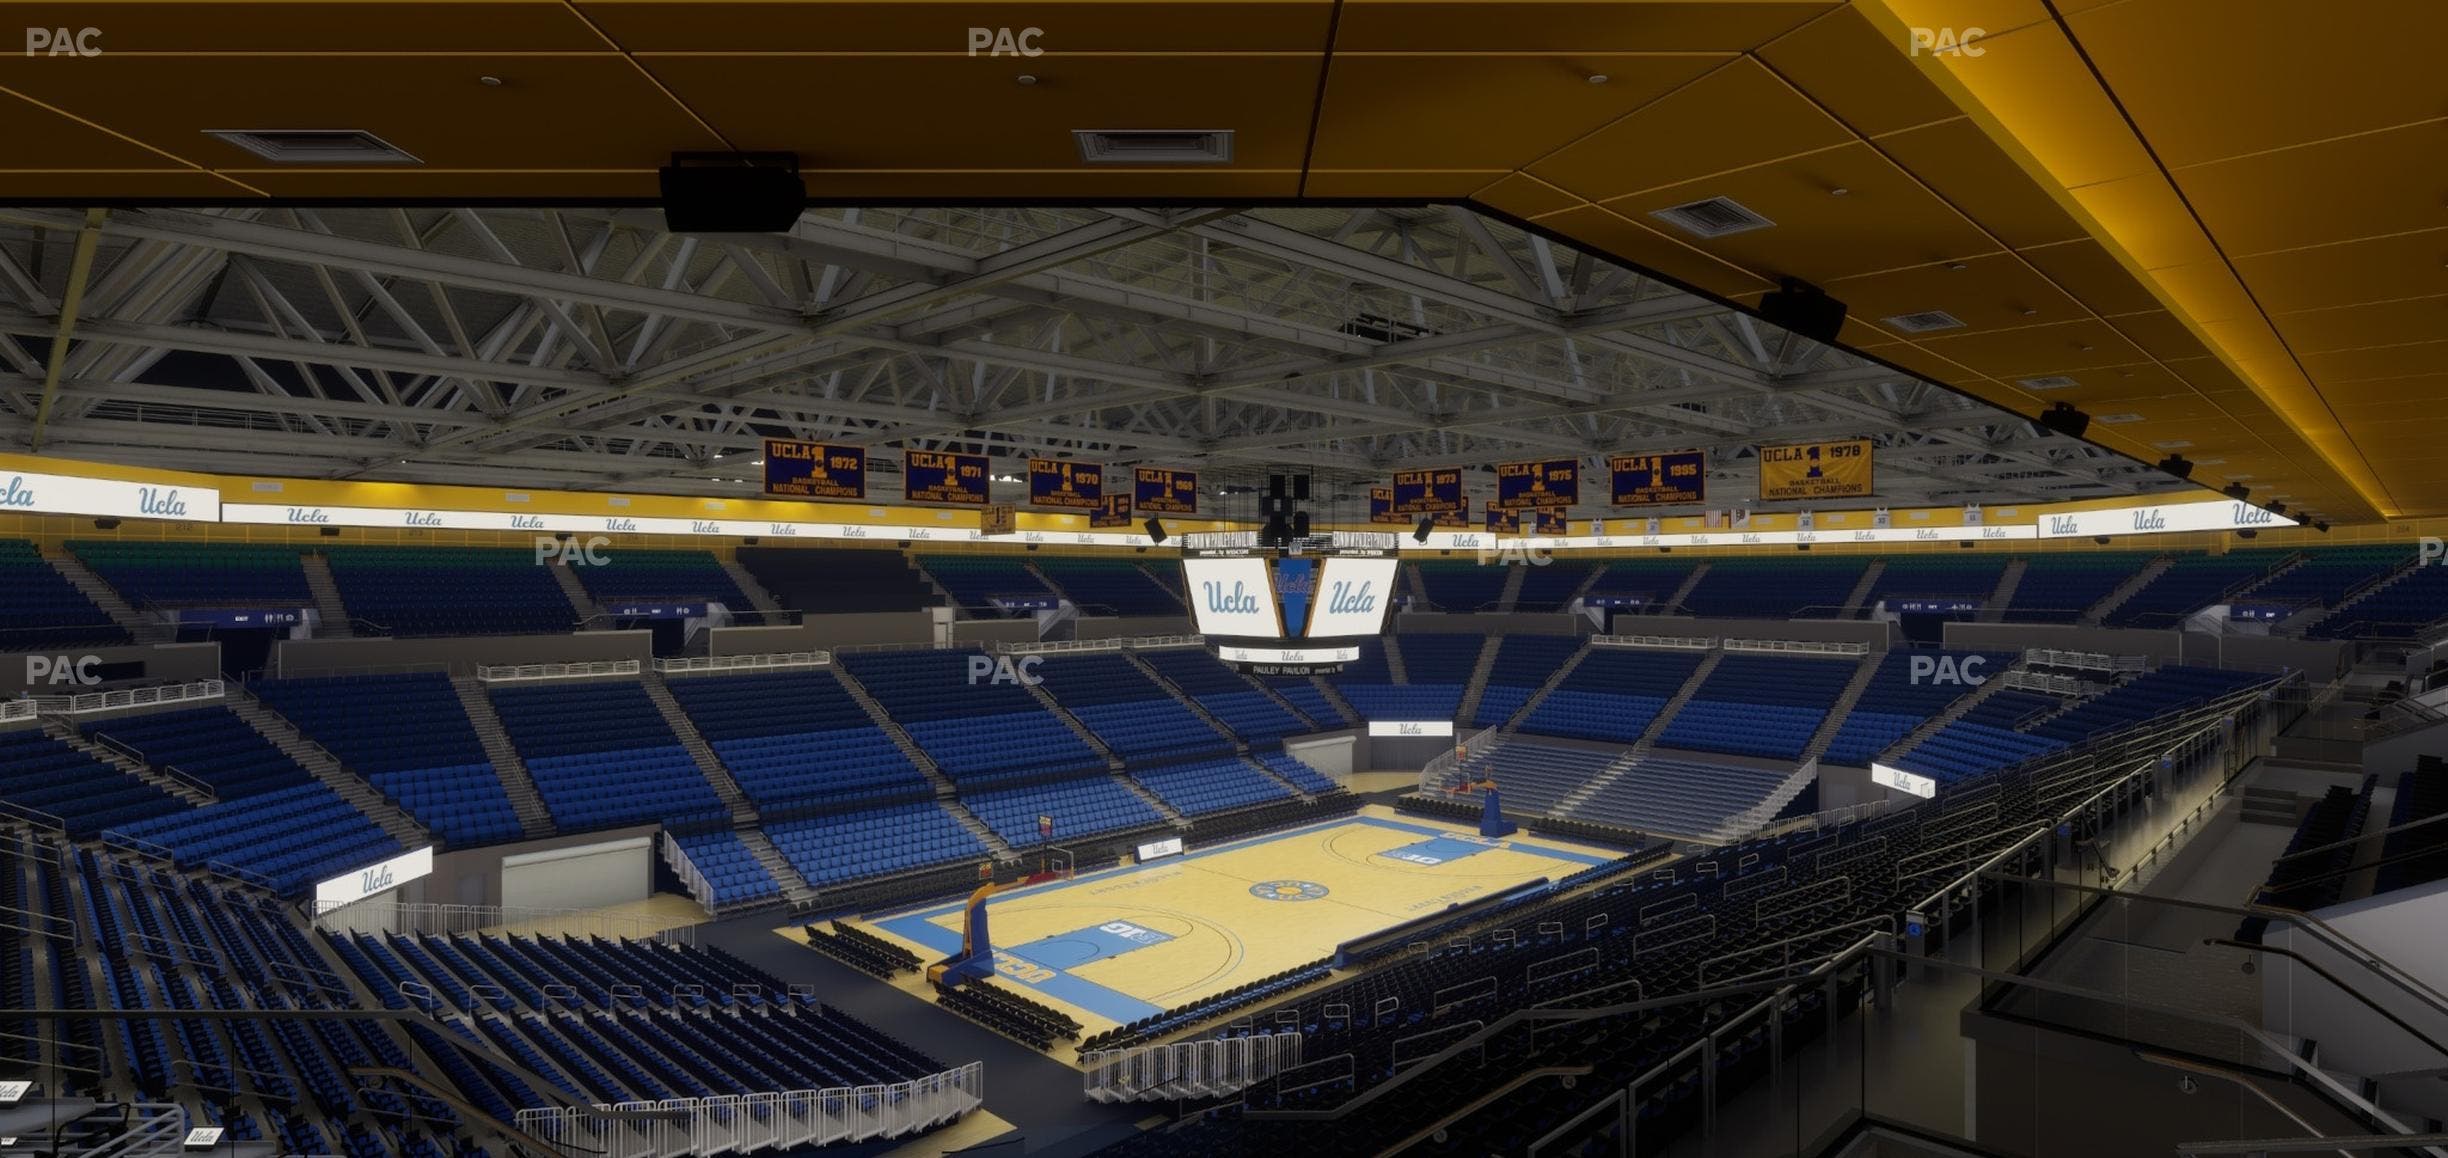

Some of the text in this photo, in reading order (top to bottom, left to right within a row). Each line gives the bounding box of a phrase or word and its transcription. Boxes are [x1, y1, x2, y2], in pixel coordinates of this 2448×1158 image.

[772, 443, 858, 479] UCLA 1 1972
[1763, 445, 1862, 478] UCLA 1 1978
[911, 454, 982, 486] UCLA 1 1971
[1031, 460, 1099, 492] UCLA 1 1970
[1613, 459, 1648, 472] UCLA
[1650, 457, 1663, 487] 1
[792, 477, 838, 487] BASKETBALL
[1138, 470, 1164, 483] UCLA
[1163, 472, 1174, 498] 1
[1500, 465, 1529, 477] UCLA
[1531, 463, 1545, 492] 1
[1789, 478, 1840, 487] BASKETBALL
[0, 475, 35, 507] cla
[772, 483, 858, 498] NATIONAL CHAMPIONS
[928, 484, 967, 493] BASKETBALL
[1397, 473, 1423, 486] UCLA
[1423, 471, 1434, 498] 1
[1635, 486, 1678, 494] BASKETBALL
[1768, 484, 1863, 497] NATIONAL CHAMPIONS
[138, 487, 188, 516] Ucla
[911, 490, 983, 503] NATIONAL CHAMPIONS
[1033, 495, 1062, 505] NATIONAL
[1063, 497, 1100, 507] CHAMPIONS
[1504, 496, 1572, 506] NATIONAL CHAMPIONS
[1618, 491, 1697, 503] NATIONAL CHAMPIONS
[287, 507, 330, 524] Ucla
[405, 511, 442, 526] Ucla
[2232, 502, 2273, 525] Ucla
[510, 515, 545, 529] Ucla
[606, 518, 637, 532] Ucla
[691, 520, 720, 534] Ucla
[2050, 515, 2079, 535] Ucla
[2132, 510, 2165, 531] Ucla
[771, 523, 796, 535] Ucla
[843, 526, 867, 537] Ucla
[908, 529, 930, 539] Ucla
[1854, 531, 1875, 540] Ucla
[1916, 529, 1938, 539] Ucla
[1983, 528, 2006, 538] Ucla
[1025, 532, 1044, 542] Ucla
[1077, 534, 1095, 544] Ucla
[1452, 534, 1480, 547] Ucla
[1643, 537, 1660, 545] Ucla
[1690, 535, 1709, 544] Ucla
[1742, 534, 1761, 543] Ucla
[1797, 533, 1816, 542] Ucla
[1276, 573, 1315, 594] Ucla
[1203, 580, 1260, 614] Ucla
[1329, 580, 1376, 614] Ucla
[1280, 650, 1304, 662] Ucla
[1253, 665, 1280, 675] PAULEY
[1282, 666, 1311, 675] PAVILION
[1399, 723, 1422, 735] Ucla
[362, 864, 393, 894] Ucla
[190, 1130, 214, 1143] Ucla
